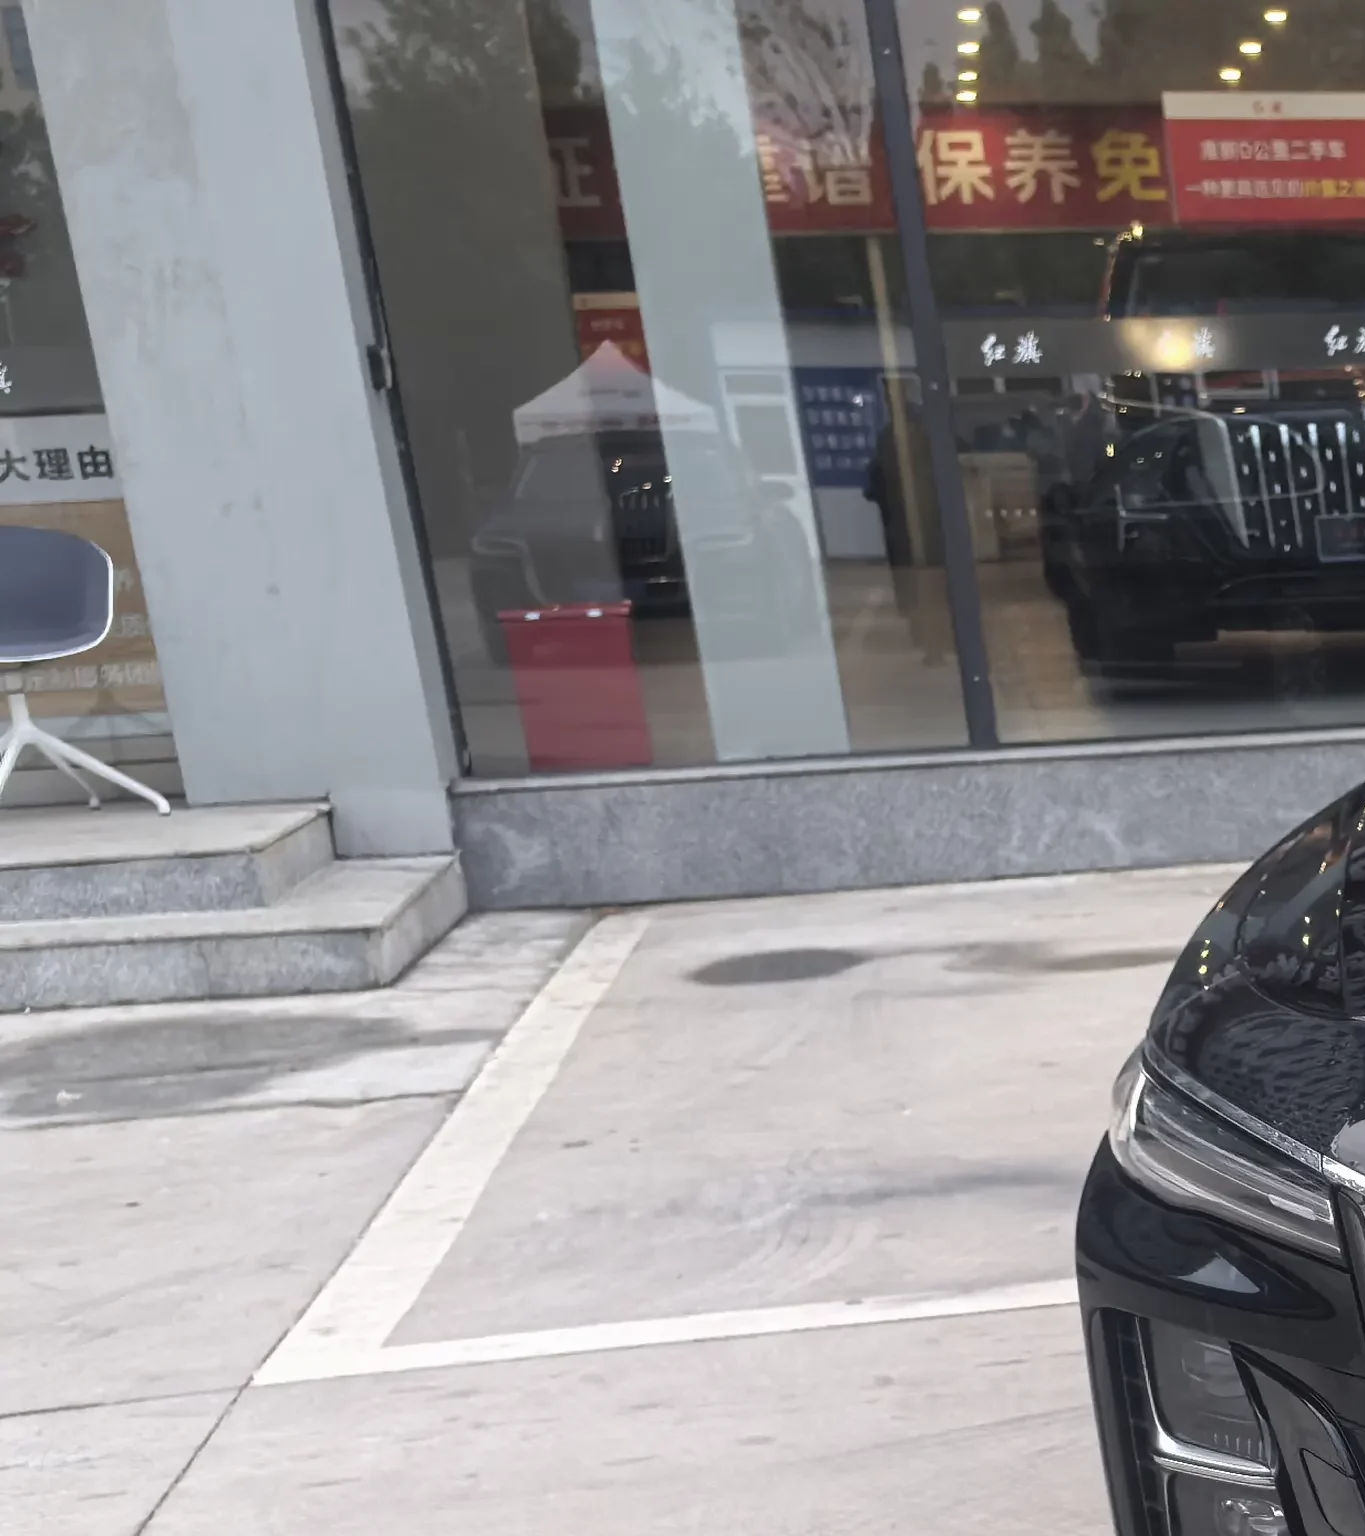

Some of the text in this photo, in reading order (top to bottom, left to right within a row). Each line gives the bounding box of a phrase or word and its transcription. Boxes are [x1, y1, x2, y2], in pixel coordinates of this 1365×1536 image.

[980, 331, 1043, 367] 红旗
[0, 443, 114, 482] 大理由
